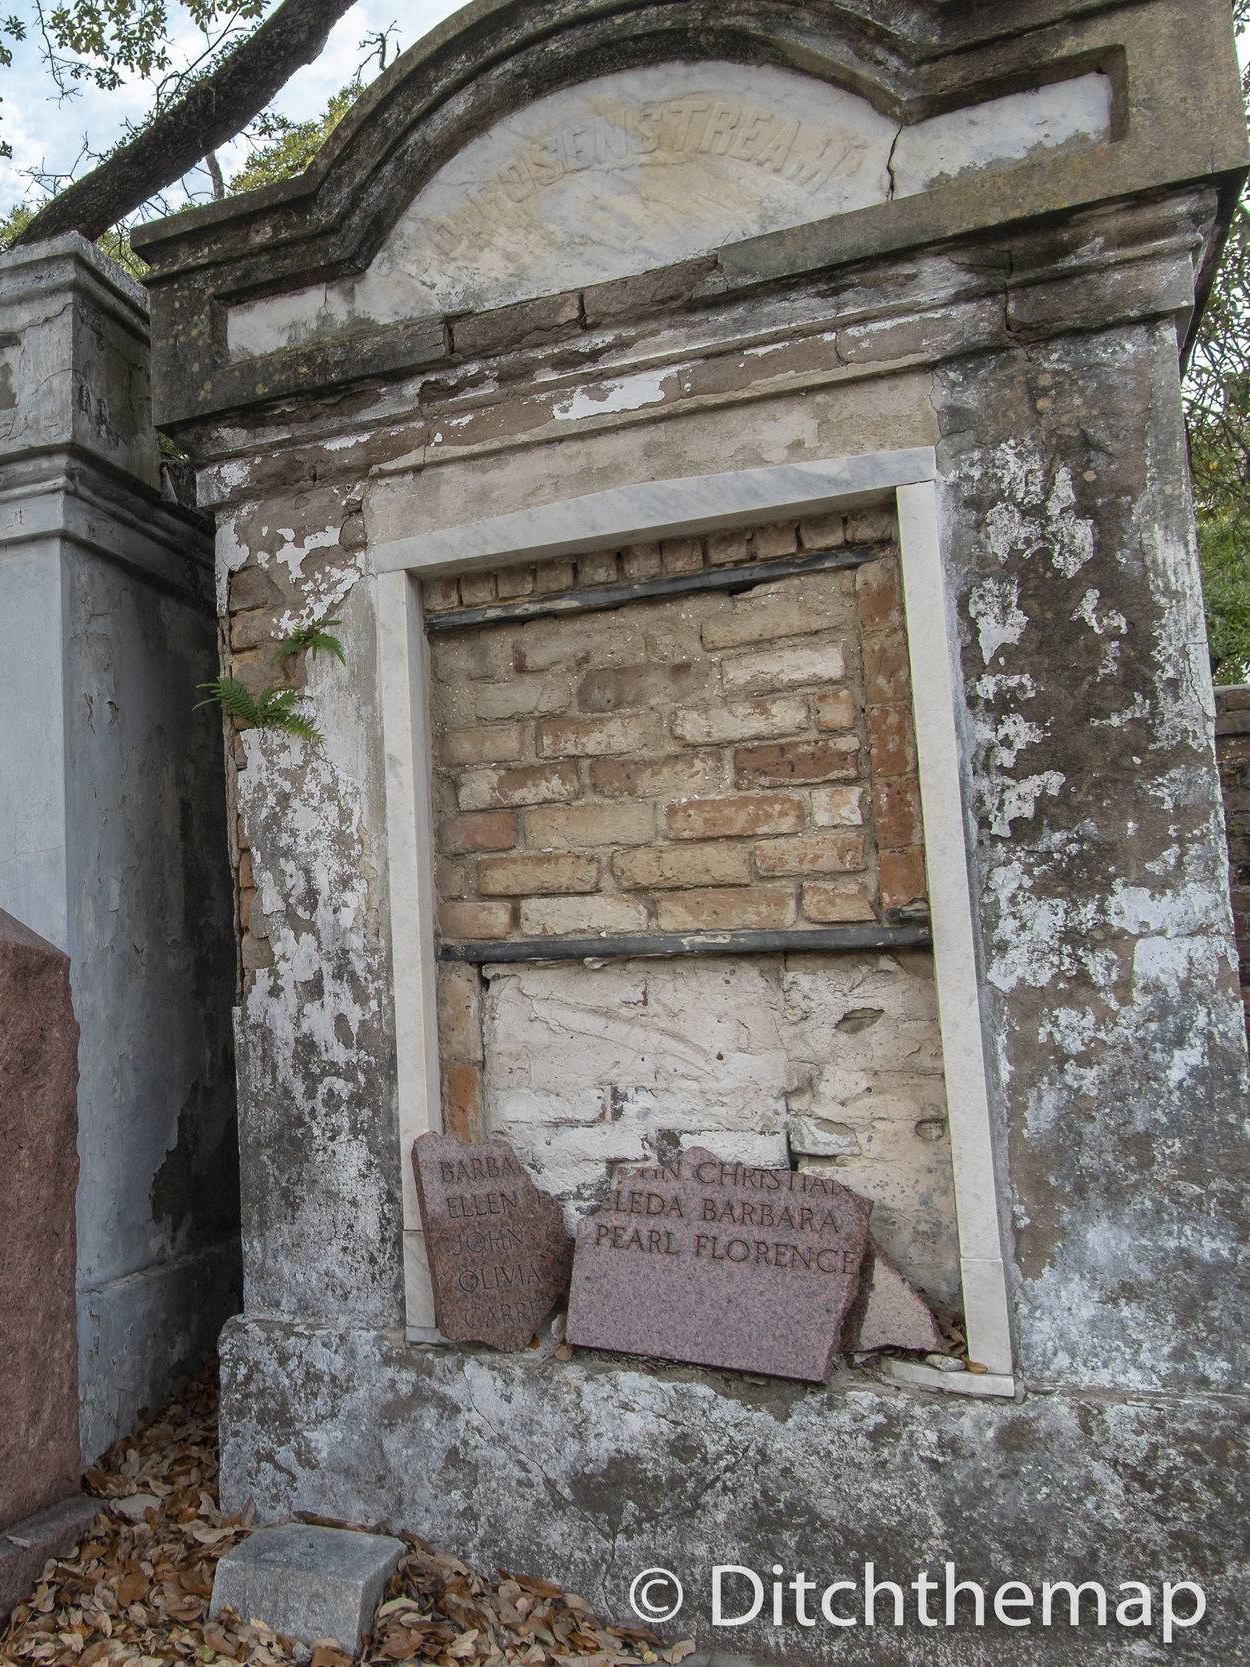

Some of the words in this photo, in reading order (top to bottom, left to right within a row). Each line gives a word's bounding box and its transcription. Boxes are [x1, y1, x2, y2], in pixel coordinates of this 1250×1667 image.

[440, 1156, 522, 1183] BARBA
[446, 1191, 518, 1219] ELLEN
[701, 1198, 840, 1234] BARBARA
[453, 1228, 524, 1257] JOHN
[595, 1224, 679, 1256] PEARL
[695, 1234, 857, 1275] FLORENCE
[458, 1263, 543, 1293] OLIVIA
